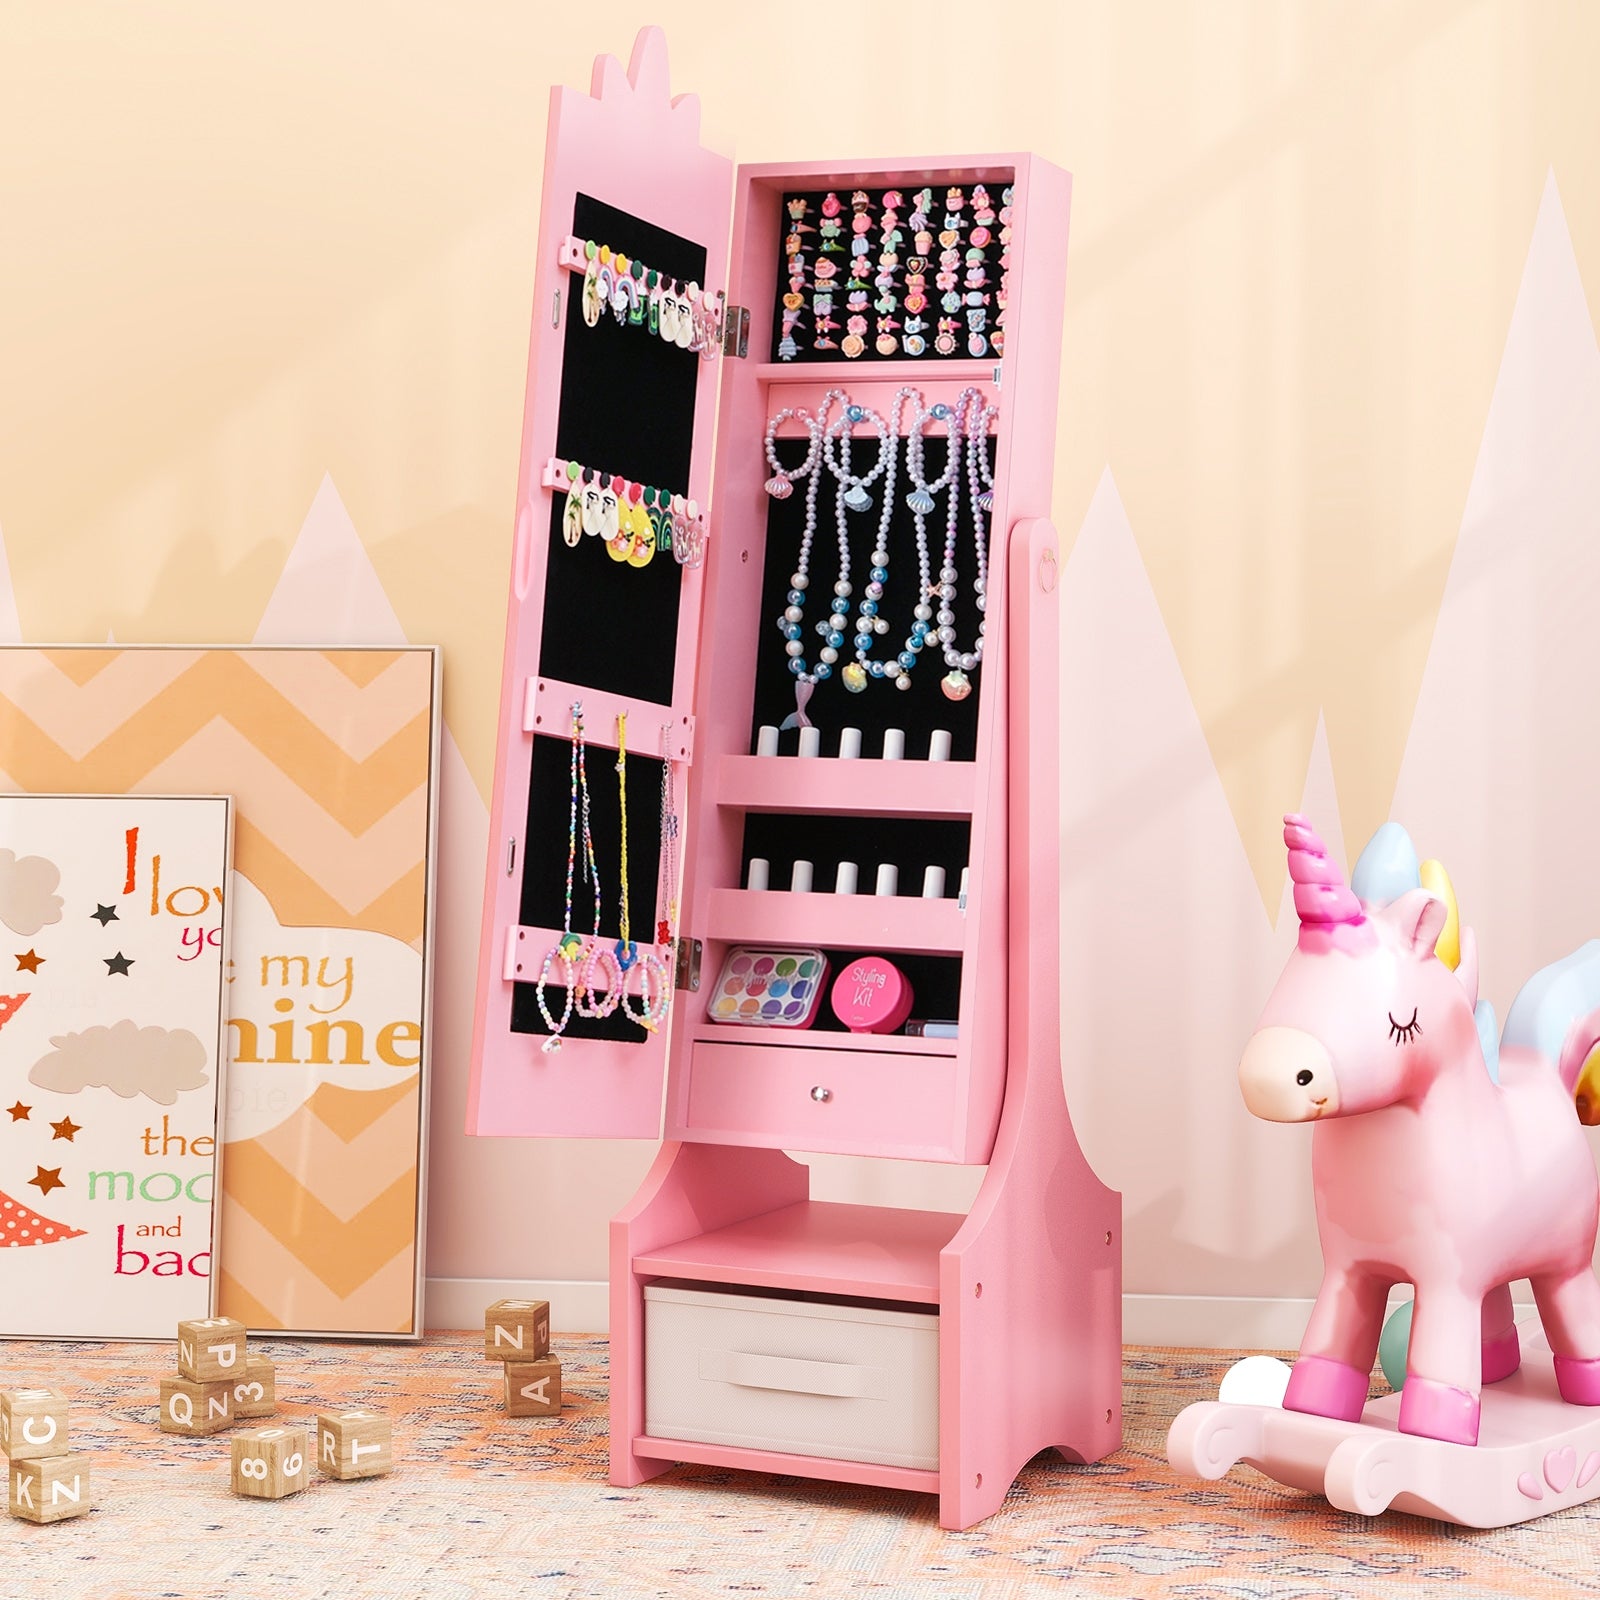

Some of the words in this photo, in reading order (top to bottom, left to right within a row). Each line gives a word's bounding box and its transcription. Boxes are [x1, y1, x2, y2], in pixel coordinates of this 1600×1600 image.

[260, 955, 353, 1014] my
[851, 966, 887, 989] Styling
[852, 986, 874, 1007] Kit
[140, 1115, 215, 1157] the
[136, 1215, 182, 1238] and
[208, 1344, 236, 1368] P
[234, 1382, 264, 1403] 3
[520, 1376, 551, 1405] A
[169, 1393, 194, 1428] Q
[22, 1415, 57, 1445] C
[323, 1430, 336, 1466] R
[351, 1439, 381, 1465] T
[240, 1457, 268, 1480] 8
[16, 1472, 35, 1509] K
